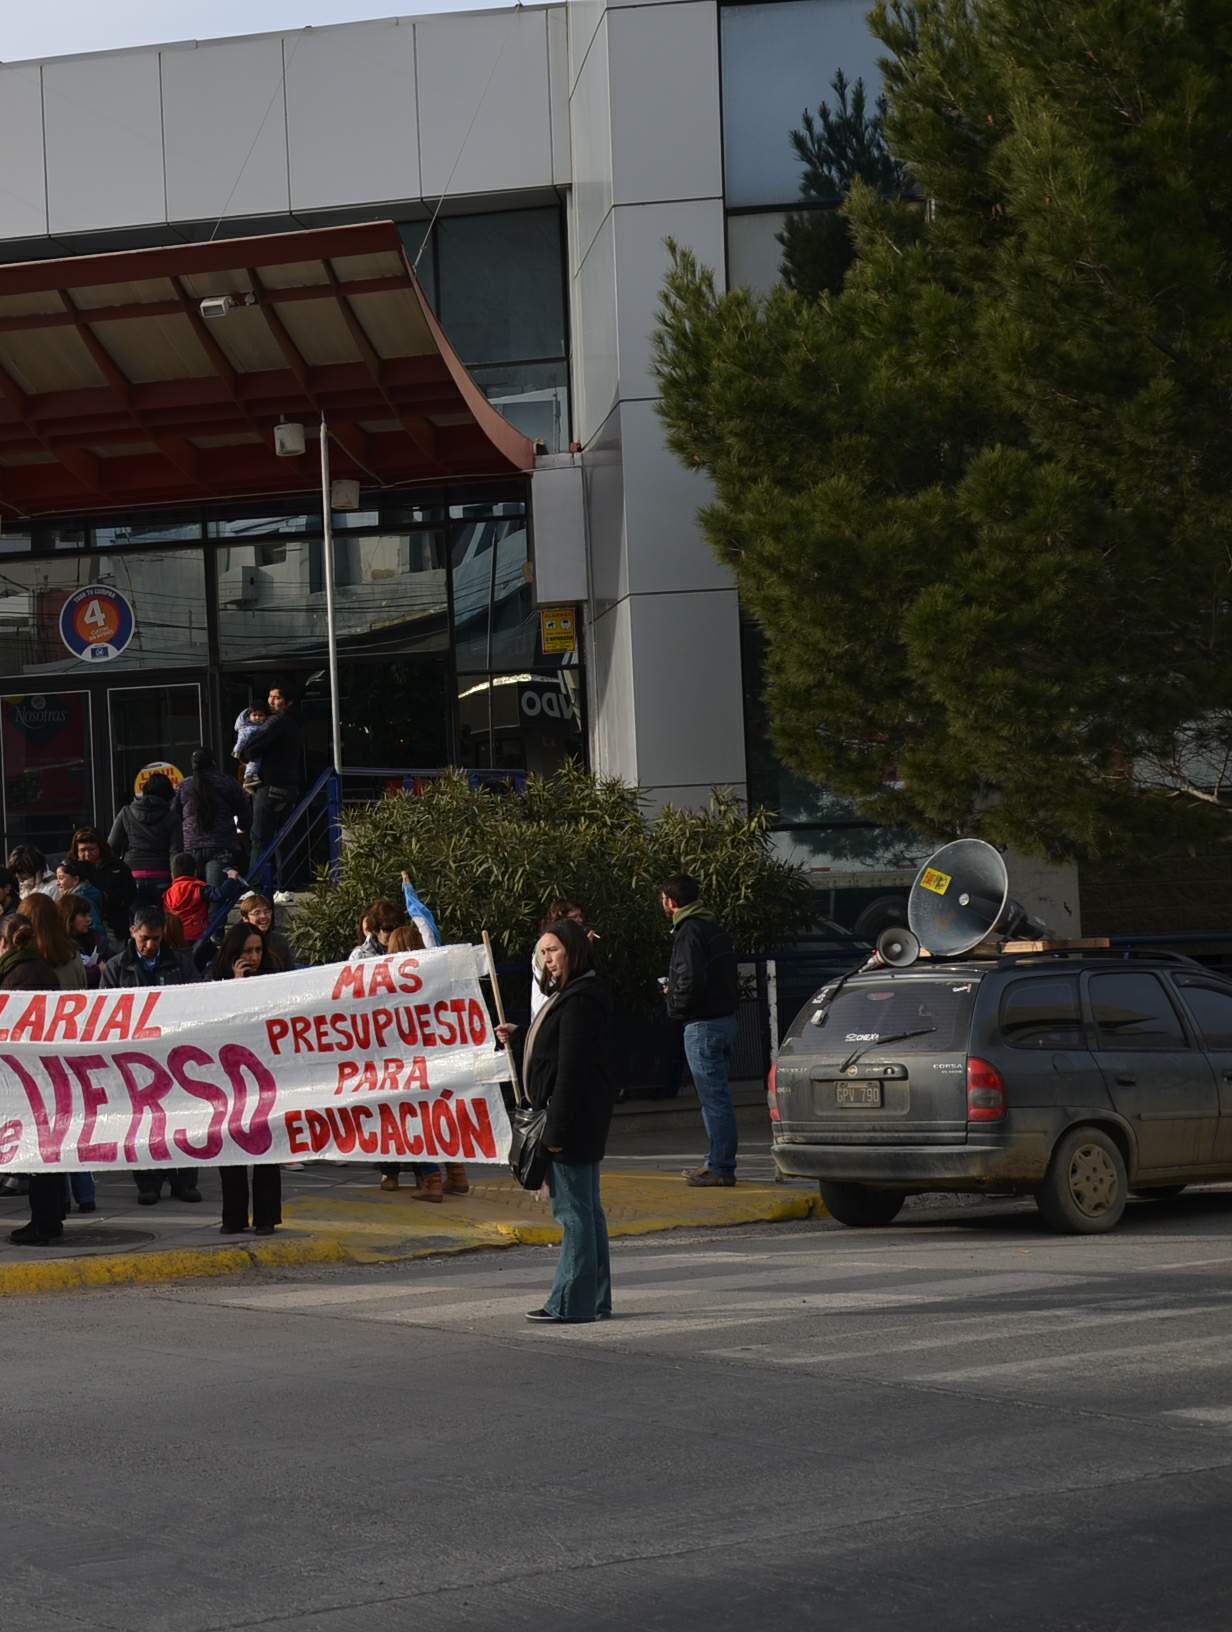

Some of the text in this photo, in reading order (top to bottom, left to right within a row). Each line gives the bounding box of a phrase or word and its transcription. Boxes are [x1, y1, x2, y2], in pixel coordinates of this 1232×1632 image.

[84, 599, 106, 627] 4
[265, 998, 488, 1055] PRESUPUESTO
[334, 1056, 431, 1095] PARA
[862, 1087, 879, 1102] 790
[284, 1088, 498, 1159] EDUCACIÓN
